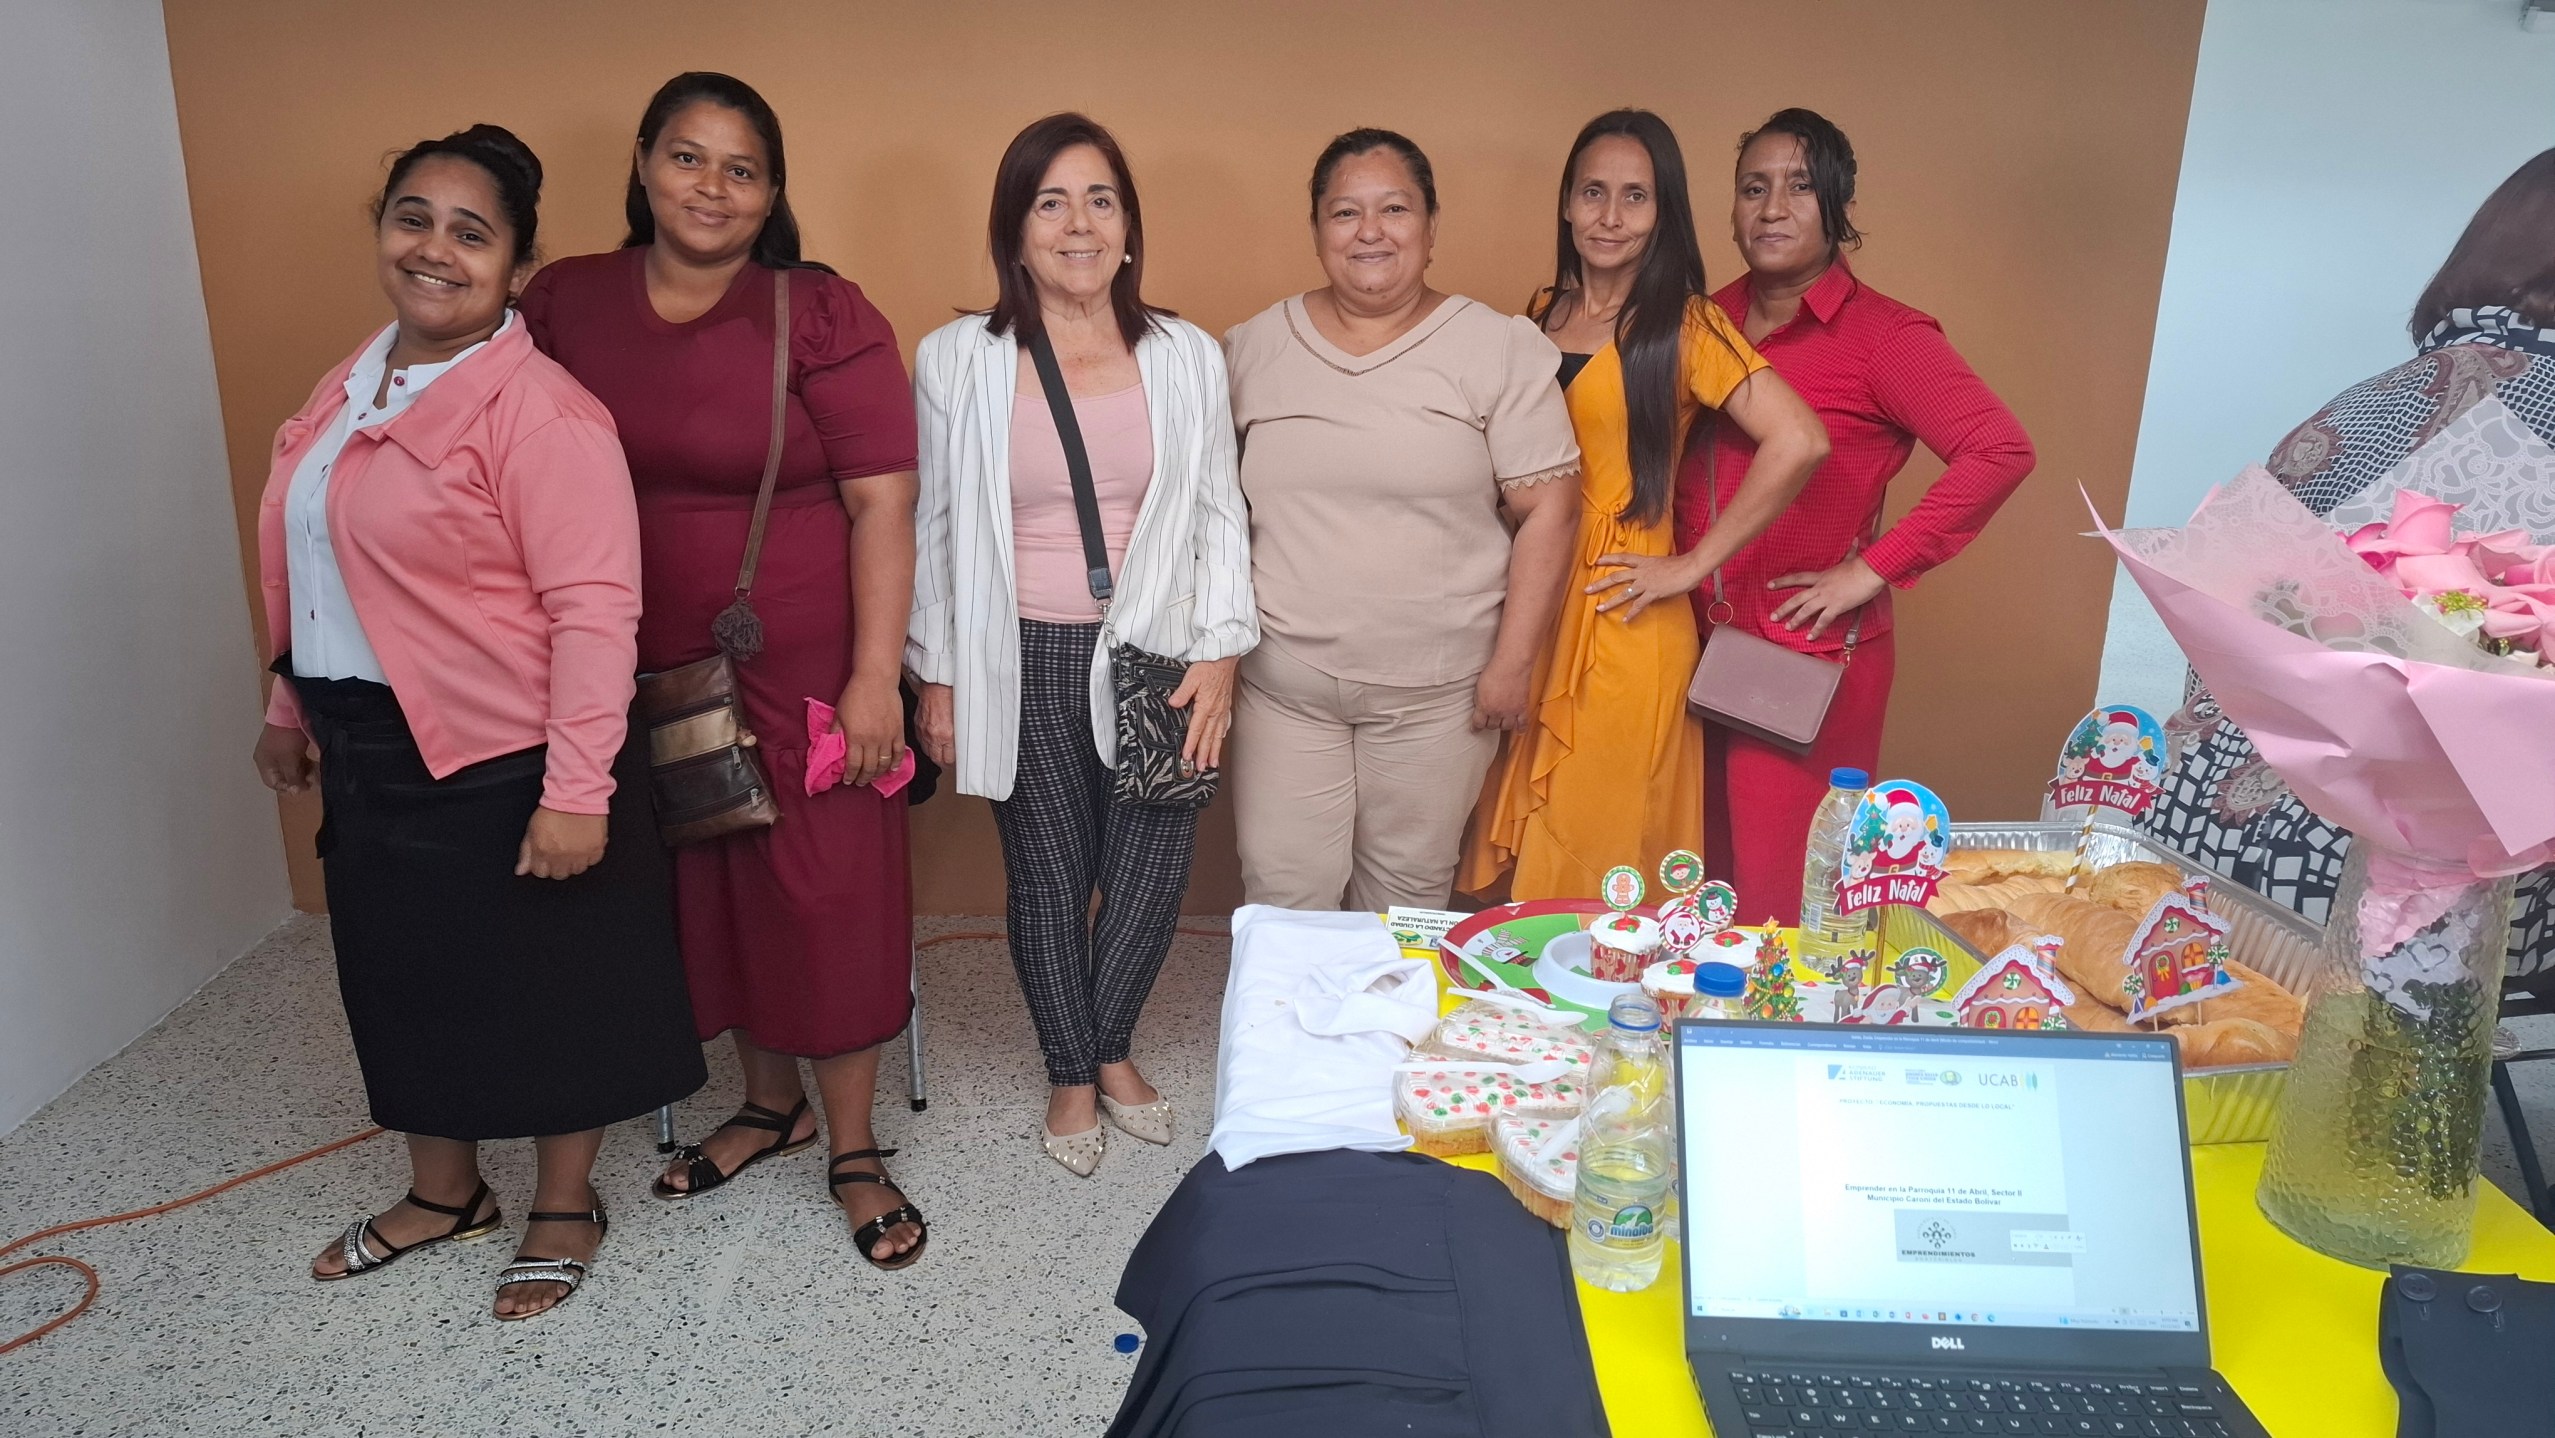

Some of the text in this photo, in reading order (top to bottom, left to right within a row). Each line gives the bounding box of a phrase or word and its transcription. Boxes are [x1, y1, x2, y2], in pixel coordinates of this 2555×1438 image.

[2060, 784, 2141, 810] Feliz Natal
[1846, 878, 1928, 911] Feliz Natal
[1397, 915, 1438, 924] NATURALEZA
[1978, 1073, 2019, 1087] UCAB
[1845, 1184, 1886, 1193] Emprender
[1899, 1185, 1906, 1193] la
[1908, 1186, 1945, 1195] Parroquia
[1957, 1187, 1967, 1195] de
[1991, 1189, 2016, 1197] Sector
[1867, 1194, 1904, 1203] Municipio
[1932, 1196, 1945, 1204] del
[1946, 1197, 1973, 1205] Estado
[1901, 1250, 1976, 1258] EMPRENDIMIENTOS
[1931, 1336, 1965, 1350] DELL
